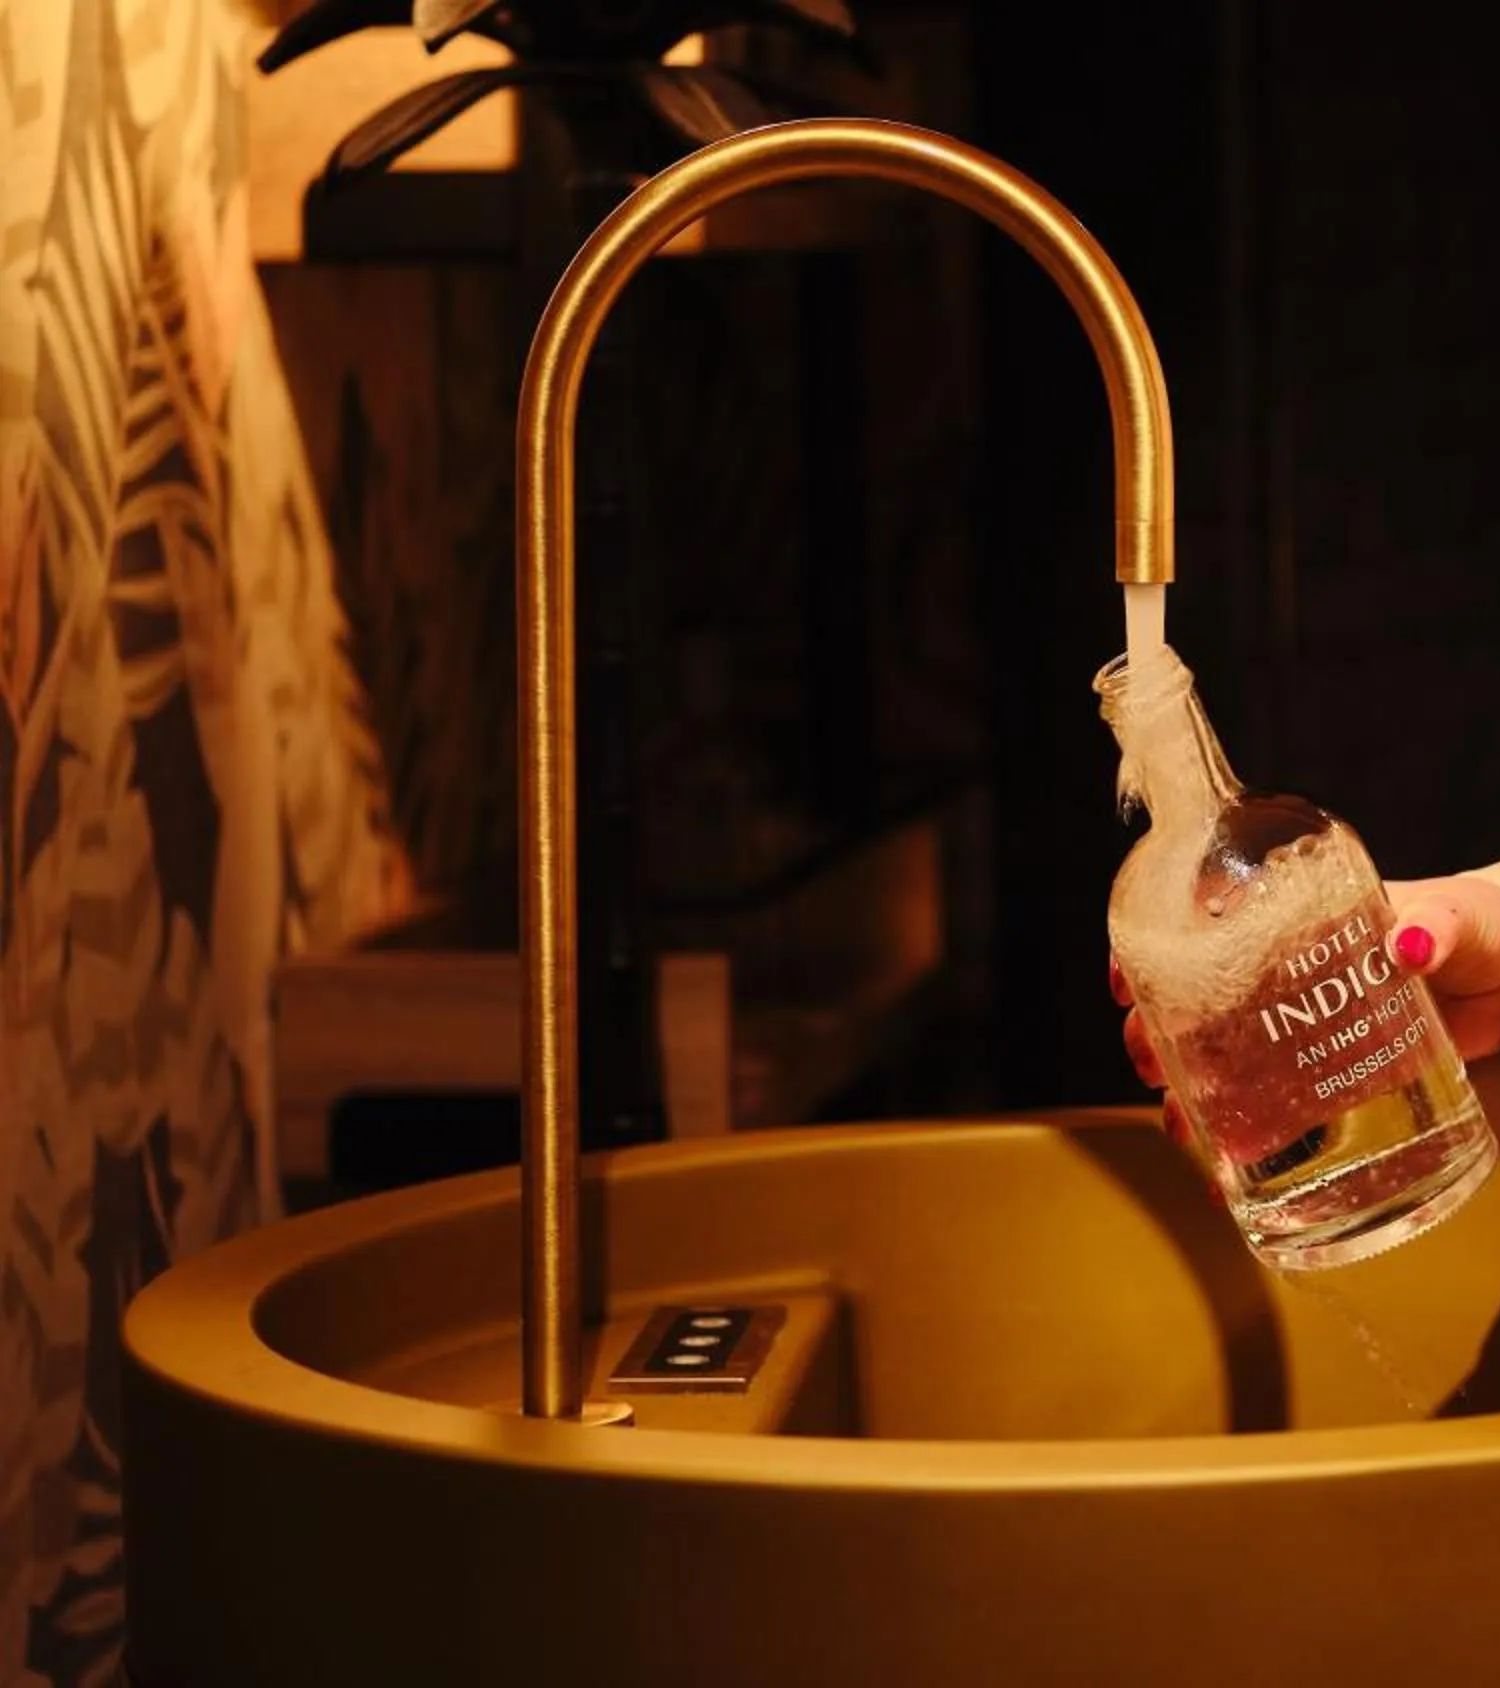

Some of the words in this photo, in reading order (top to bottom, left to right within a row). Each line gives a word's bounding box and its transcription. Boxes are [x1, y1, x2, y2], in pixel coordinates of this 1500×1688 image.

[1285, 915, 1371, 979] HOTEL
[1296, 1042, 1328, 1069] AN
[1375, 983, 1415, 1024] HOTE
[1315, 1036, 1406, 1100] BRUSSELS
